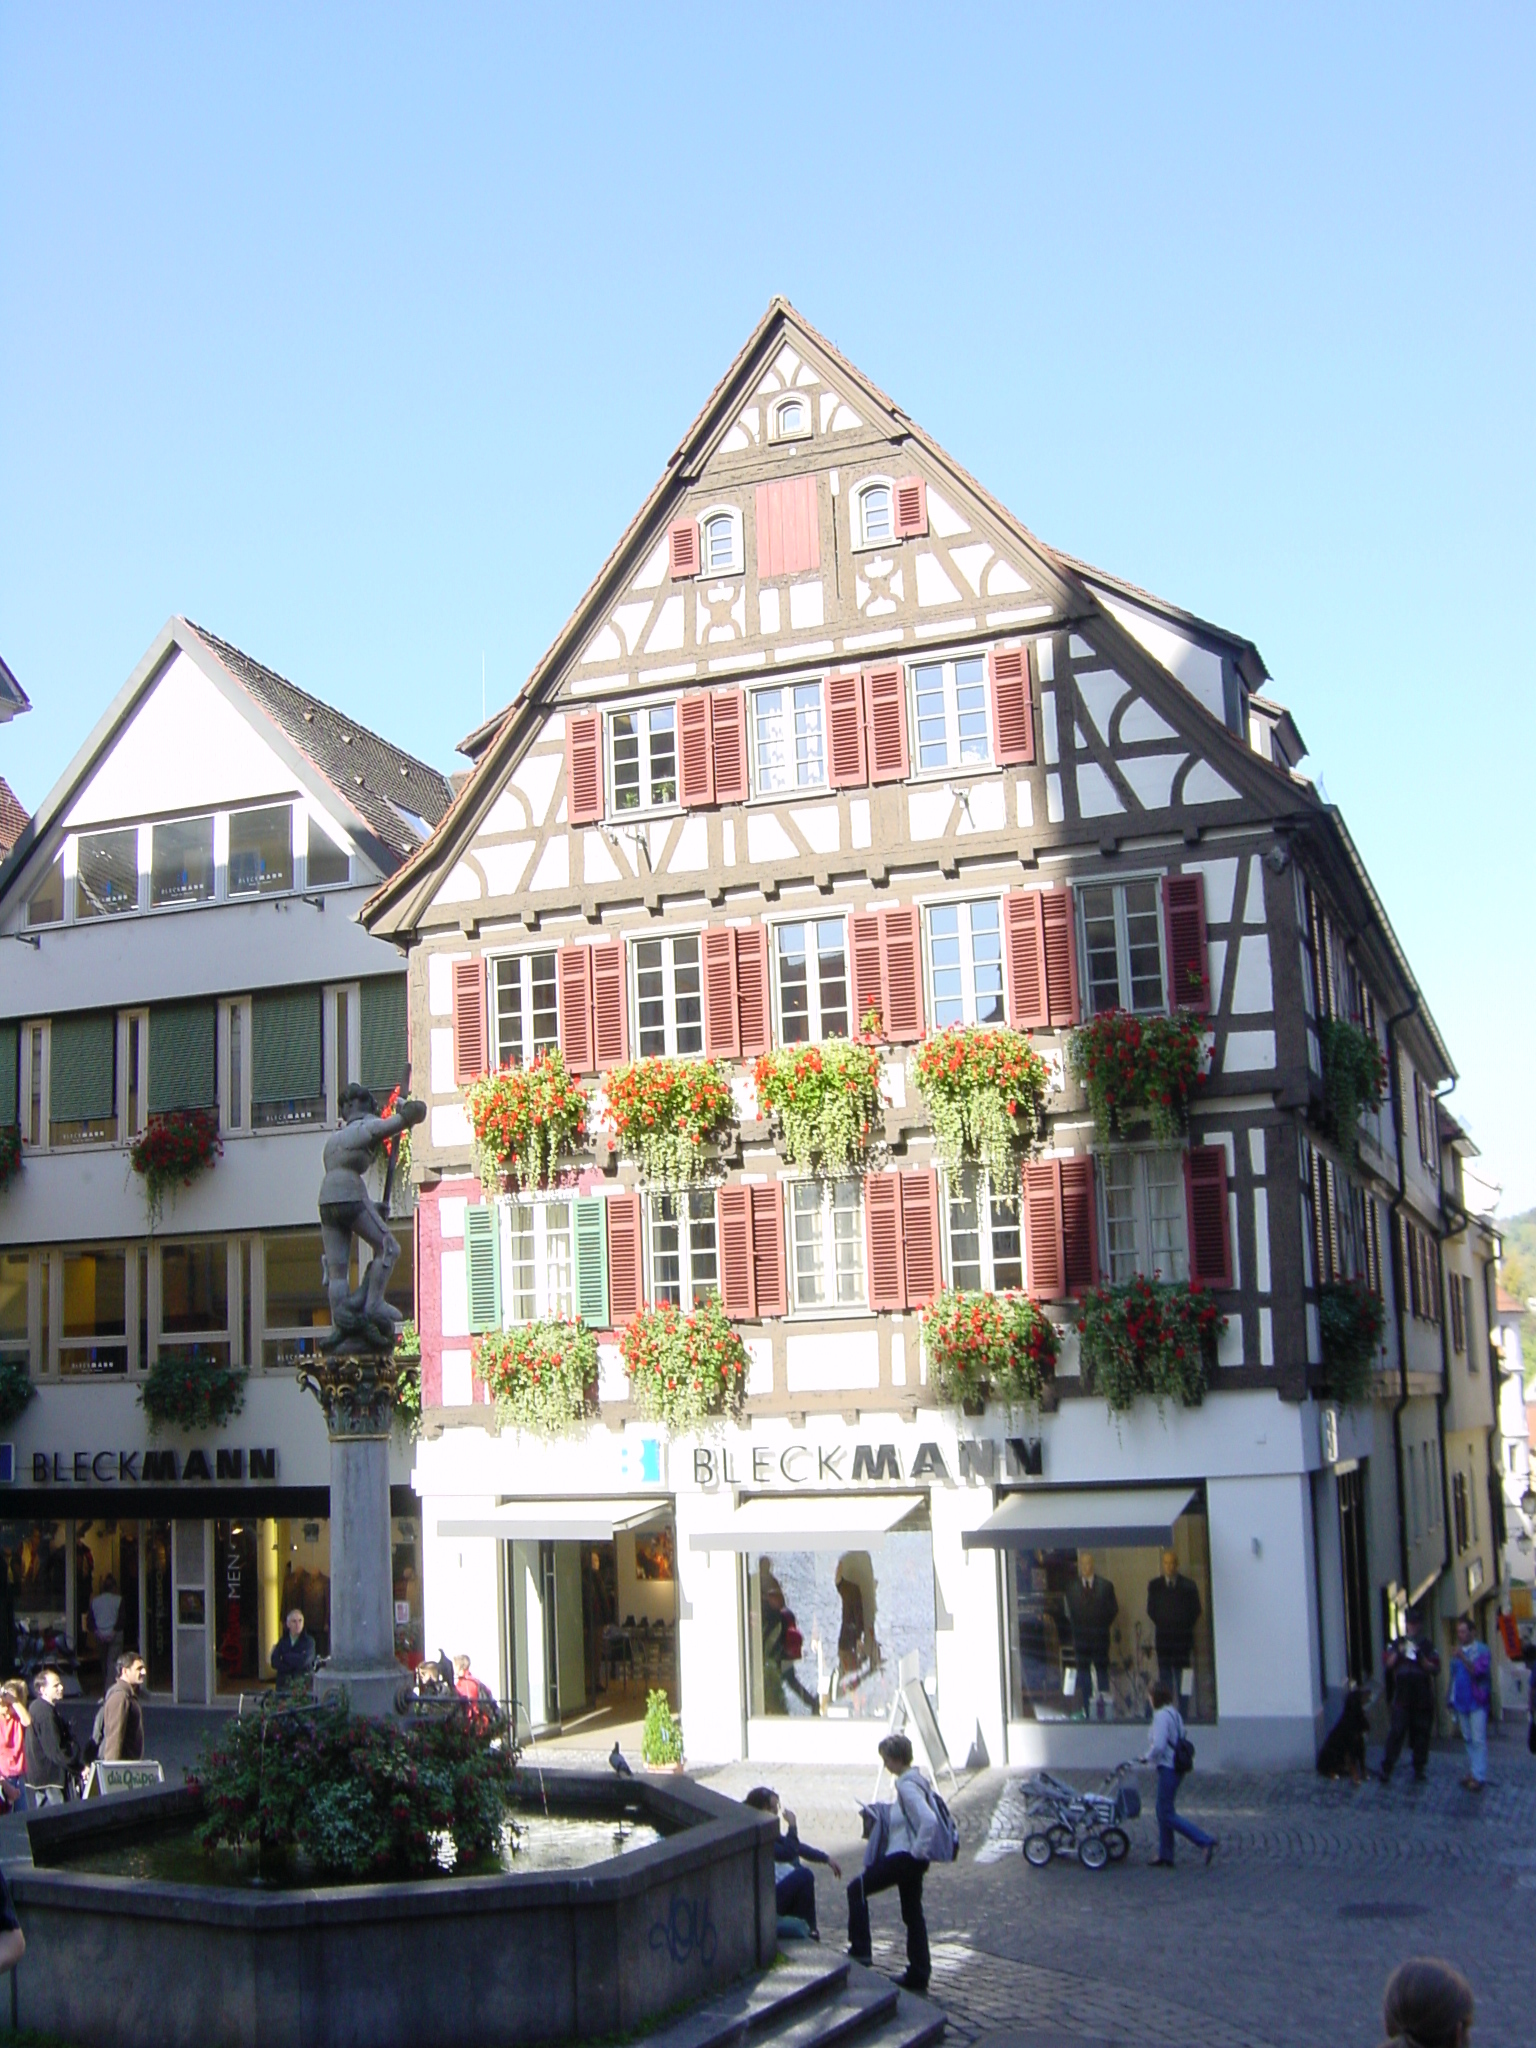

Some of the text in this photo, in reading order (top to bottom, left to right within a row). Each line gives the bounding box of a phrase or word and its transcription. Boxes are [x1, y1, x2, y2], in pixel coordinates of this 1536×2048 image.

[32, 1448, 276, 1483] BLECKMANN
[693, 1437, 1043, 1485] BLECKMANN
[227, 1553, 241, 1599] MEN
